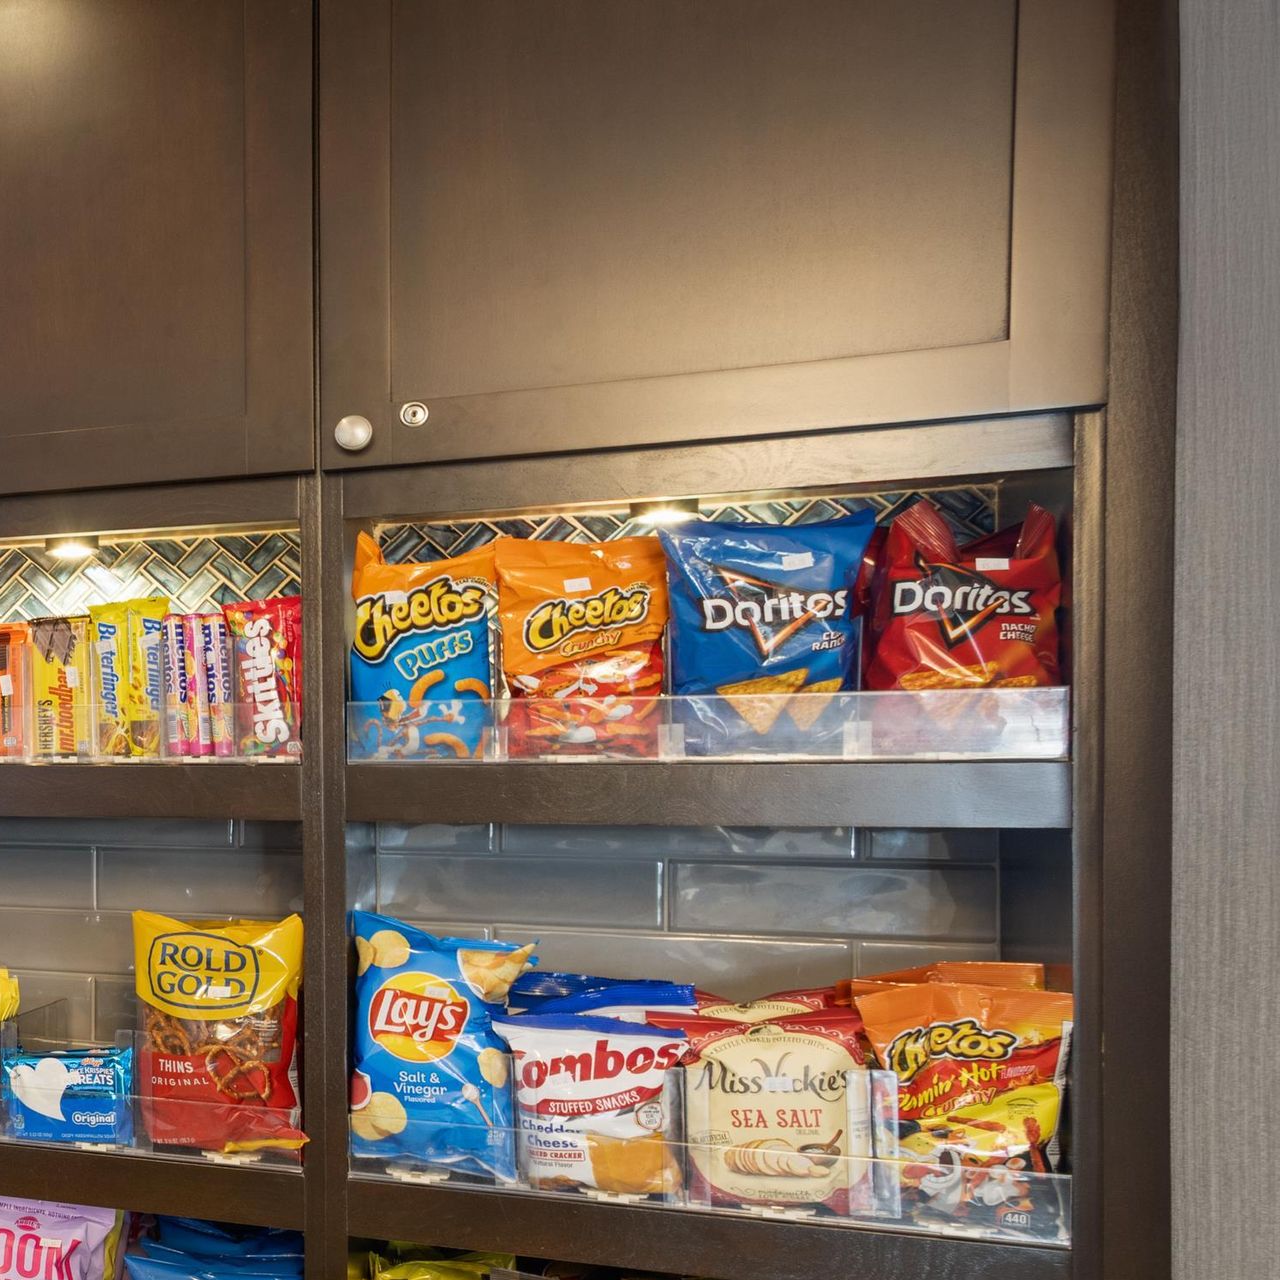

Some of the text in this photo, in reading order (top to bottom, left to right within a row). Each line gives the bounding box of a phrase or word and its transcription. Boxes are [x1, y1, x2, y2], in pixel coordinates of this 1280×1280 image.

[894, 581, 1034, 615] Doritos
[354, 578, 486, 661] Cheetos
[525, 586, 648, 650] Cheetos
[702, 590, 848, 631] Doritos
[999, 631, 1035, 642] CHEESE
[1001, 623, 1037, 632] NACHO
[559, 630, 621, 657] Crunchy
[98, 622, 119, 718] Buterfinger
[175, 623, 186, 703] mentos
[241, 618, 290, 743] Skittles
[38, 700, 54, 749] HERSHEY'S
[159, 942, 247, 973] ROLD
[157, 972, 246, 998] GOLD
[374, 989, 463, 1042] Lay's
[772, 1037, 802, 1045] POTATO
[159, 1058, 194, 1074] THINS
[399, 1071, 440, 1083] Salt &
[695, 1060, 762, 1094] Miss
[960, 1062, 1005, 1086] Hot
[75, 1075, 113, 1085] REATS
[151, 1076, 209, 1087] ORIGINAL
[394, 1082, 447, 1097] Vinegar
[548, 1090, 640, 1113] STUFFED SNACKS
[74, 1113, 115, 1124] Original
[731, 1109, 823, 1129] SEA SALT
[549, 1151, 583, 1159] CRACKER
[1006, 1213, 1027, 1224] 440
